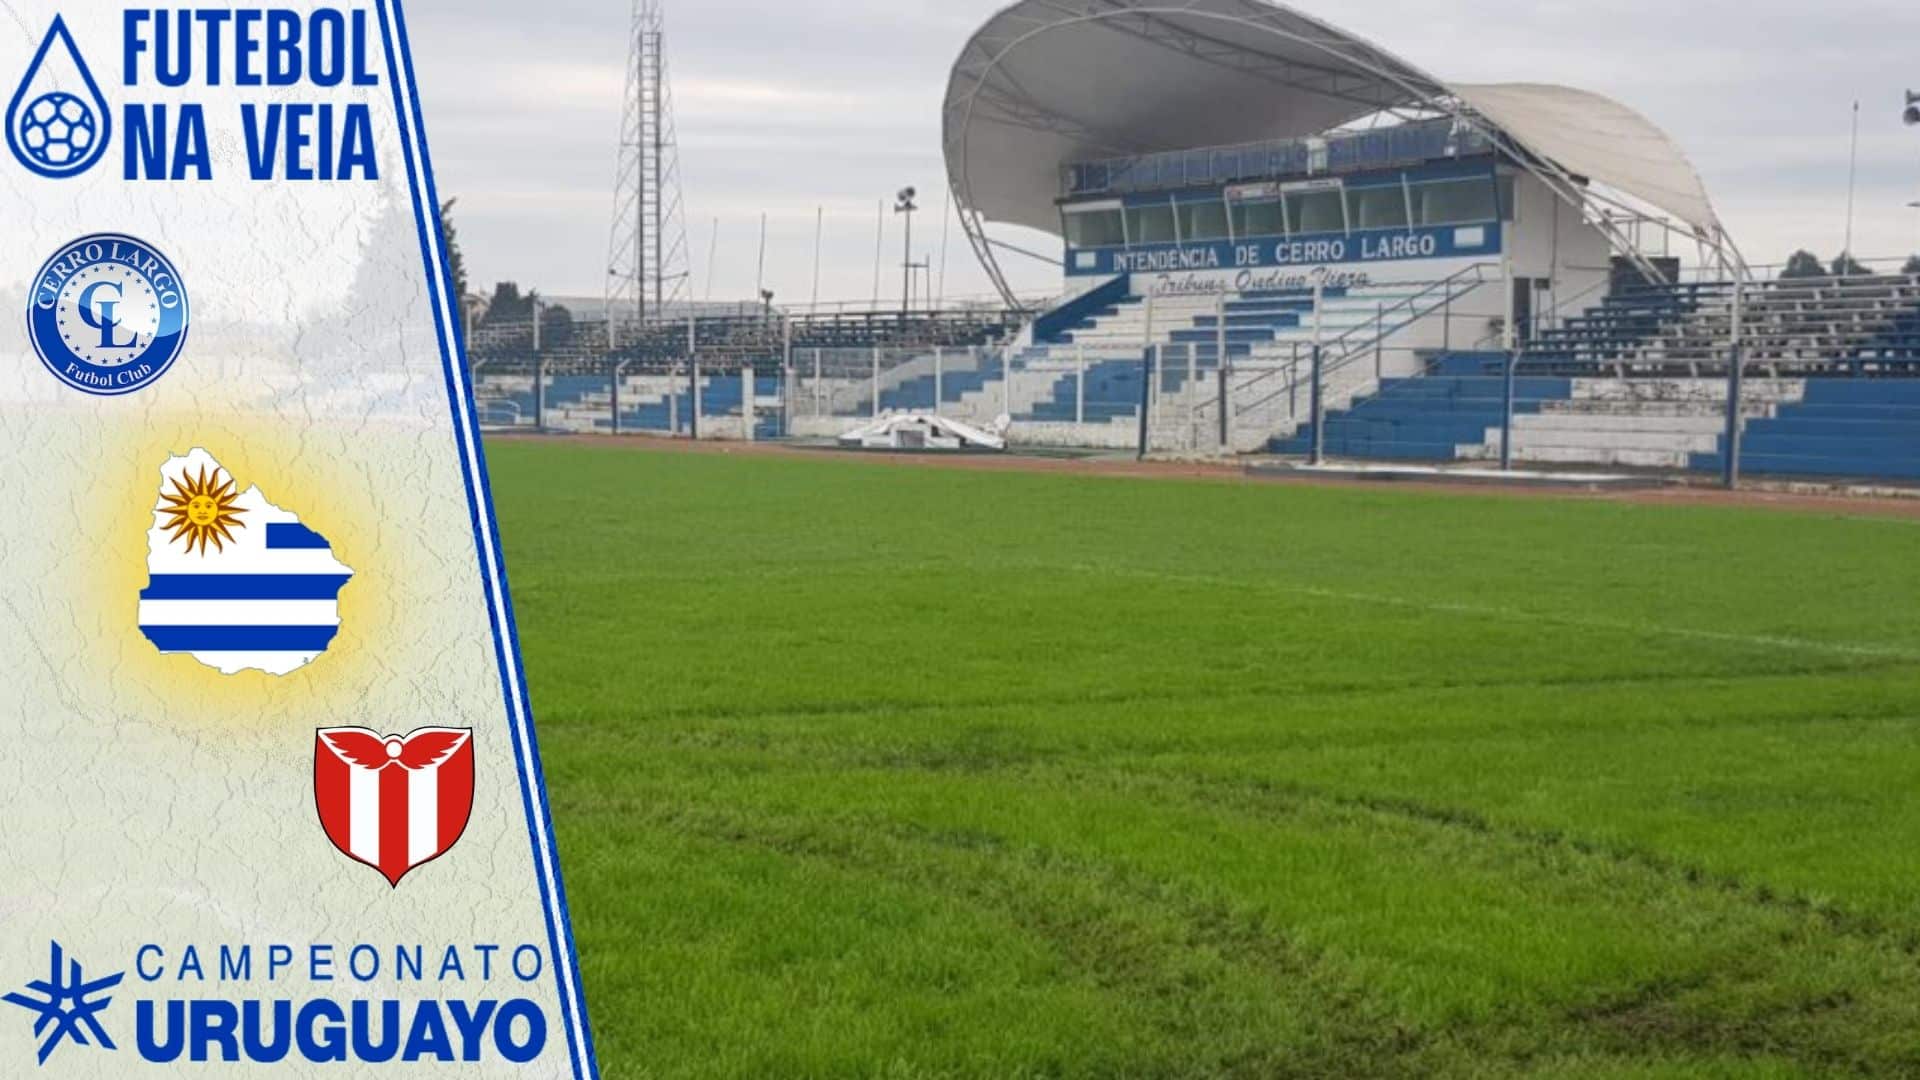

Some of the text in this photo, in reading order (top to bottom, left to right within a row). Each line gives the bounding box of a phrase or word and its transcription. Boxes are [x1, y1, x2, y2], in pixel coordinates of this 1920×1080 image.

[1112, 234, 1435, 272] INTENDENCIA DE CERRO LARGO
